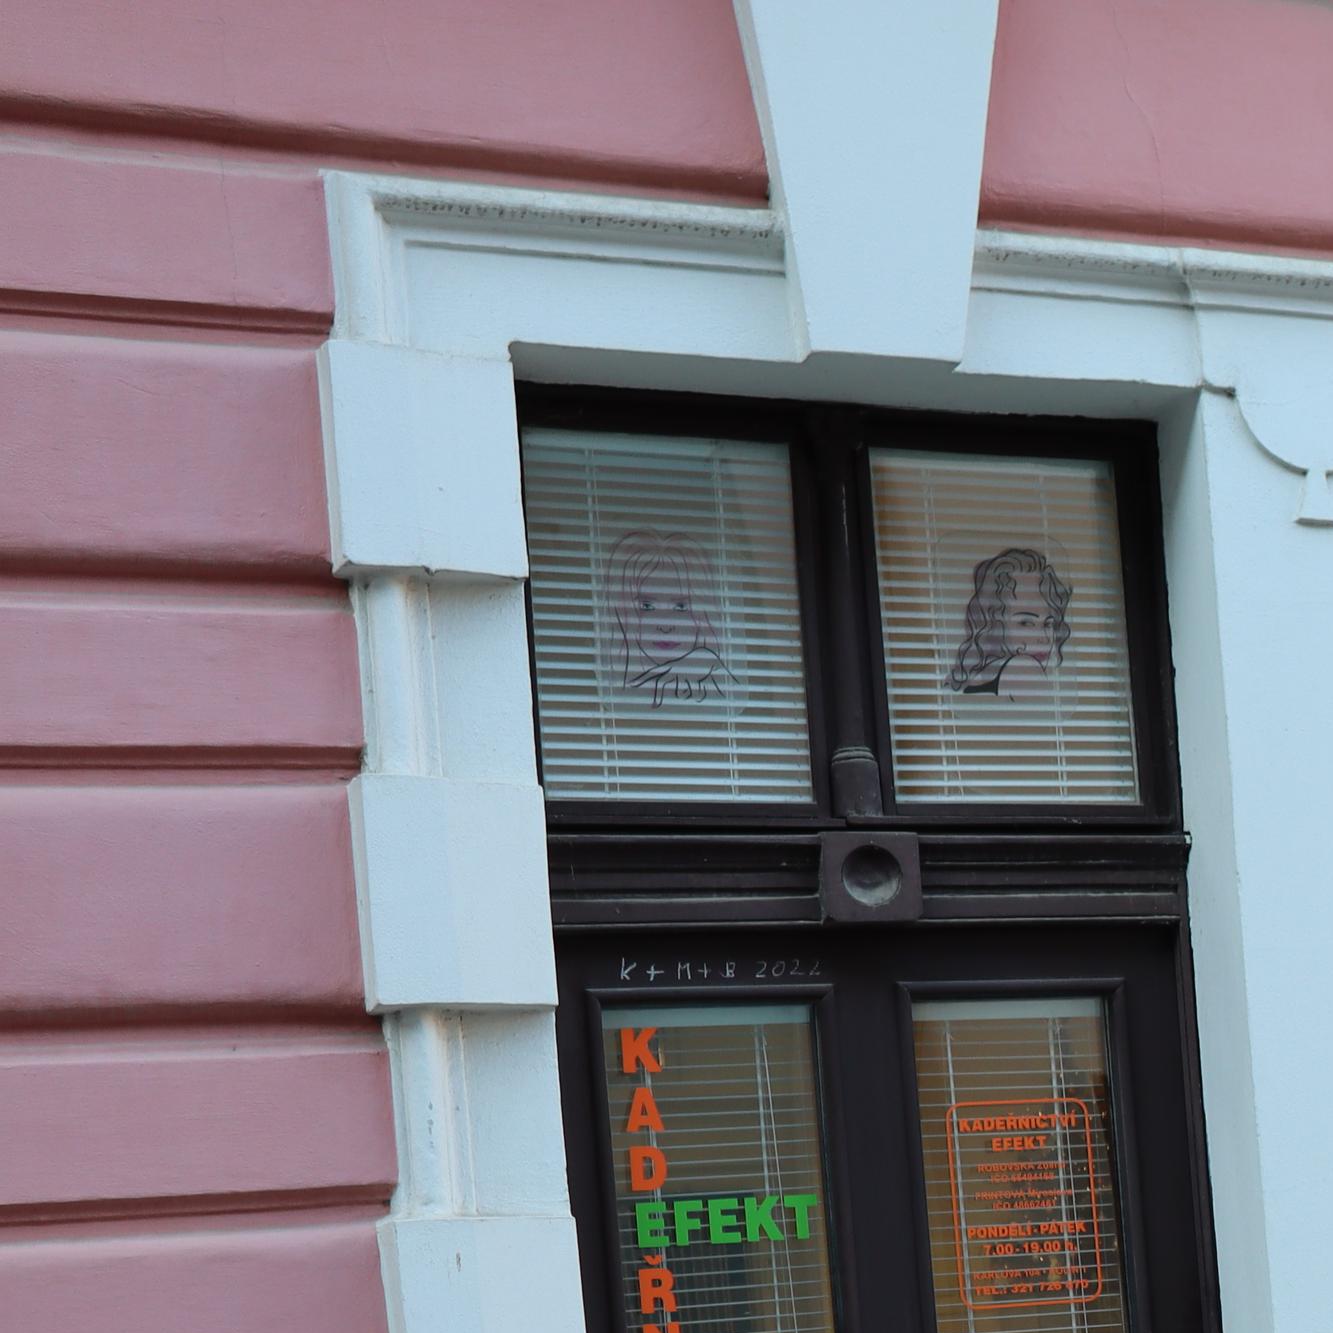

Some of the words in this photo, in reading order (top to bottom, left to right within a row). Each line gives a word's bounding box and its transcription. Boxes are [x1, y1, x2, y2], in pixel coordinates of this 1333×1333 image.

[959, 1109, 1077, 1132] KADEŘNICTVÍ
[991, 1136, 1047, 1152] EFEKT
[636, 1193, 819, 1248] EFEKT
[1011, 1283, 1033, 1294] 321
